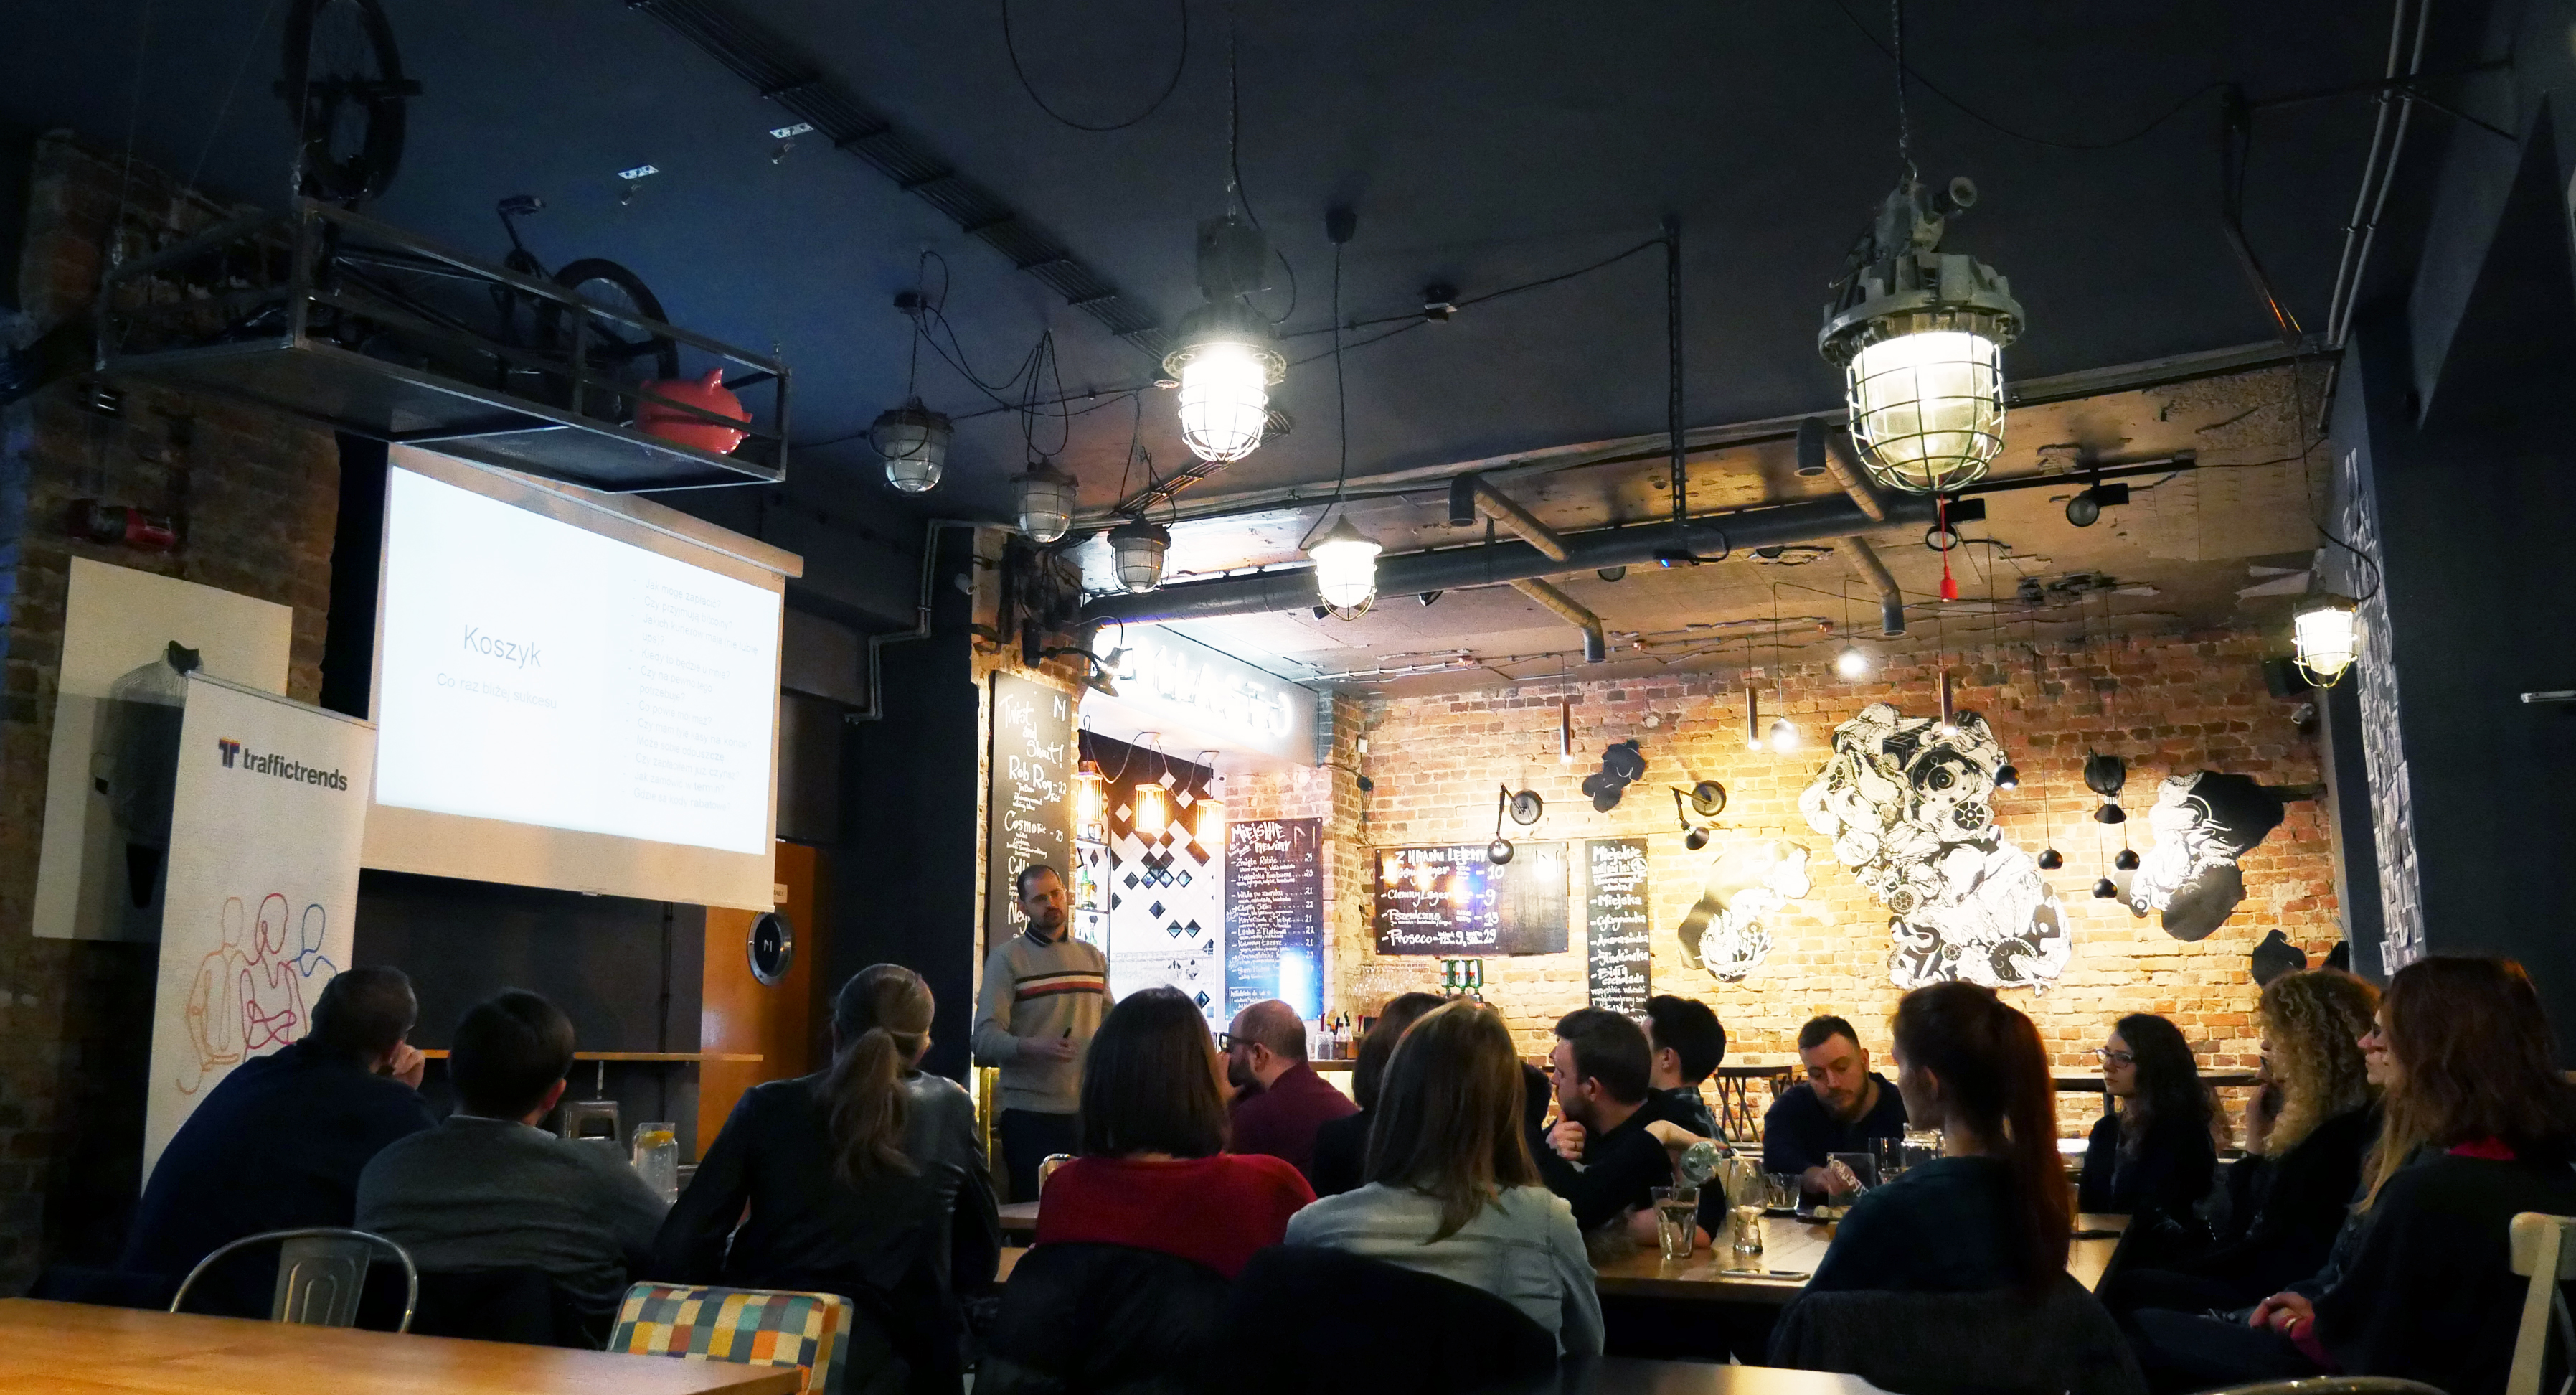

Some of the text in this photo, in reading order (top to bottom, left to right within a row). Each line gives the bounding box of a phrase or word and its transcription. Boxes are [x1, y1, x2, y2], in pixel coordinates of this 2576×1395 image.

[646, 578, 659, 591] Jak
[661, 586, 683, 601] mogę
[644, 596, 659, 611] Czy
[643, 614, 668, 629] Jakich
[464, 624, 542, 669] Koszyk
[642, 648, 664, 664] Kiedy
[666, 654, 674, 664] to
[676, 657, 701, 671] będzie
[709, 669, 730, 680] mnie?
[641, 665, 712, 693] Czy na pewno tego
[437, 672, 557, 709] Co raz bliżej sukcesu
[639, 700, 650, 711] Co
[653, 705, 675, 717] powie
[999, 694, 1034, 728] Twist
[638, 718, 653, 732] Czy
[656, 724, 674, 733] mam
[637, 735, 658, 748] Może
[661, 741, 680, 753] sobie
[636, 753, 651, 765] Czy
[244, 748, 348, 791] traffictrends
[635, 771, 648, 781] Jak
[1009, 756, 1029, 781] Rob
[1033, 764, 1052, 800] Roy
[634, 788, 656, 800] Gdzie
[669, 794, 687, 807] kody
[1395, 851, 1405, 864] Z
[1487, 865, 1504, 880] 10
[1388, 890, 1420, 907] Ciemny
[1421, 890, 1451, 906] Lager
[1483, 889, 1496, 906] 9
[1598, 894, 1642, 910] Miejska
[1387, 929, 1433, 946] Proseco
[1483, 929, 1496, 944] 29
